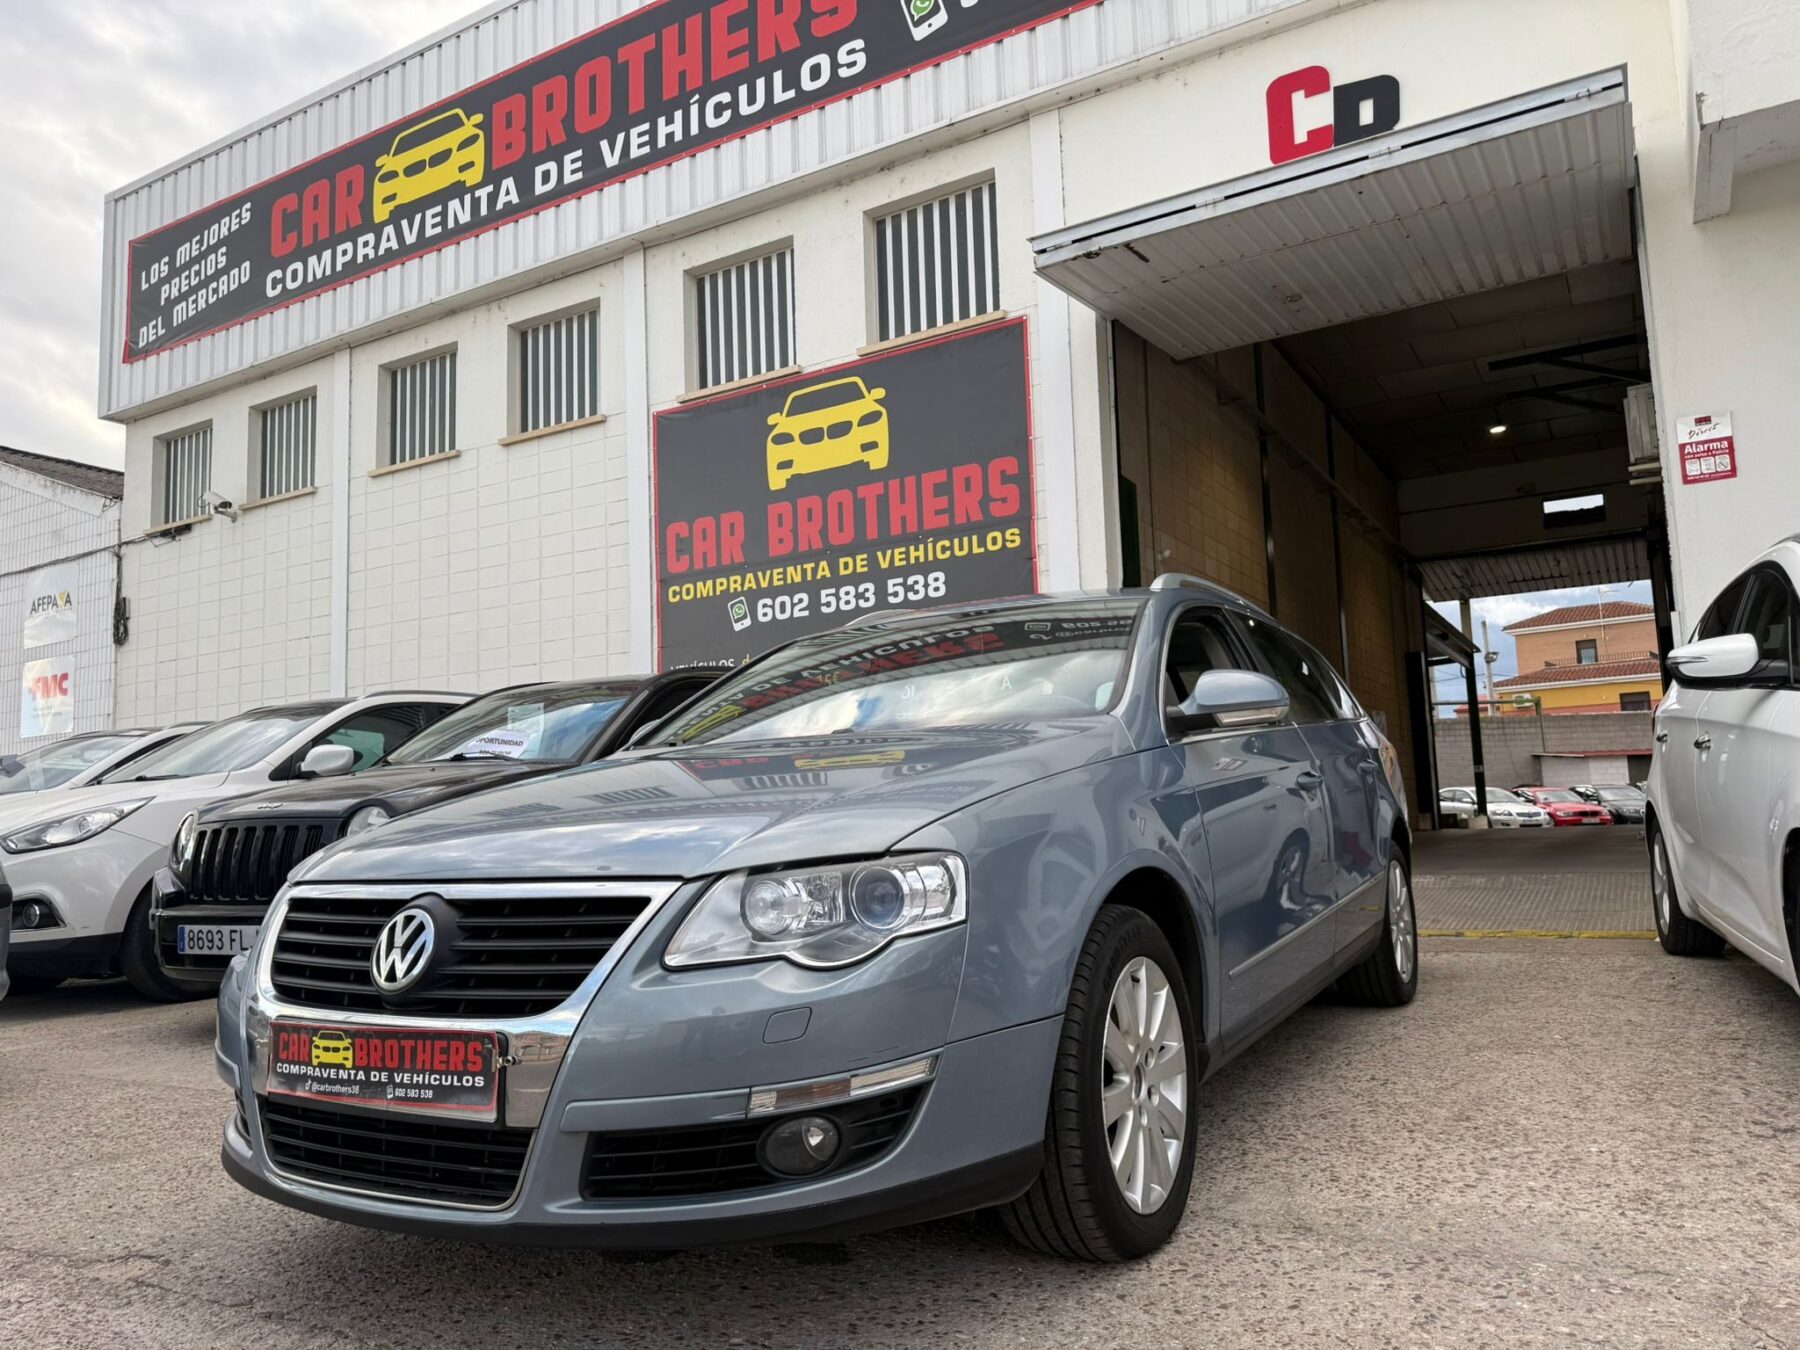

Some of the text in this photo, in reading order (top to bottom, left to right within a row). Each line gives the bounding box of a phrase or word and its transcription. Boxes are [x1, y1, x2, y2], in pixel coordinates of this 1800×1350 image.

[265, 38, 867, 298] COMPRAVENTA DE VEHÍCULOS
[270, 163, 365, 258] CAR
[141, 201, 252, 292] LOS MEJORES
[160, 246, 227, 306] PRECIOS
[138, 260, 251, 348] DEL MERCADO
[1684, 440, 1729, 454] Alarma
[665, 455, 1021, 574] CAR BROTHERS
[668, 527, 1022, 603] COMPRAVENTA DE VEHÍCULOS
[757, 571, 947, 623] 602 583 538
[187, 929, 258, 951] 8693 FL
[276, 1063, 485, 1087] COMPRAVENTA DE VEHÍCULOS
[279, 1032, 483, 1072] CAR BROTHERS
